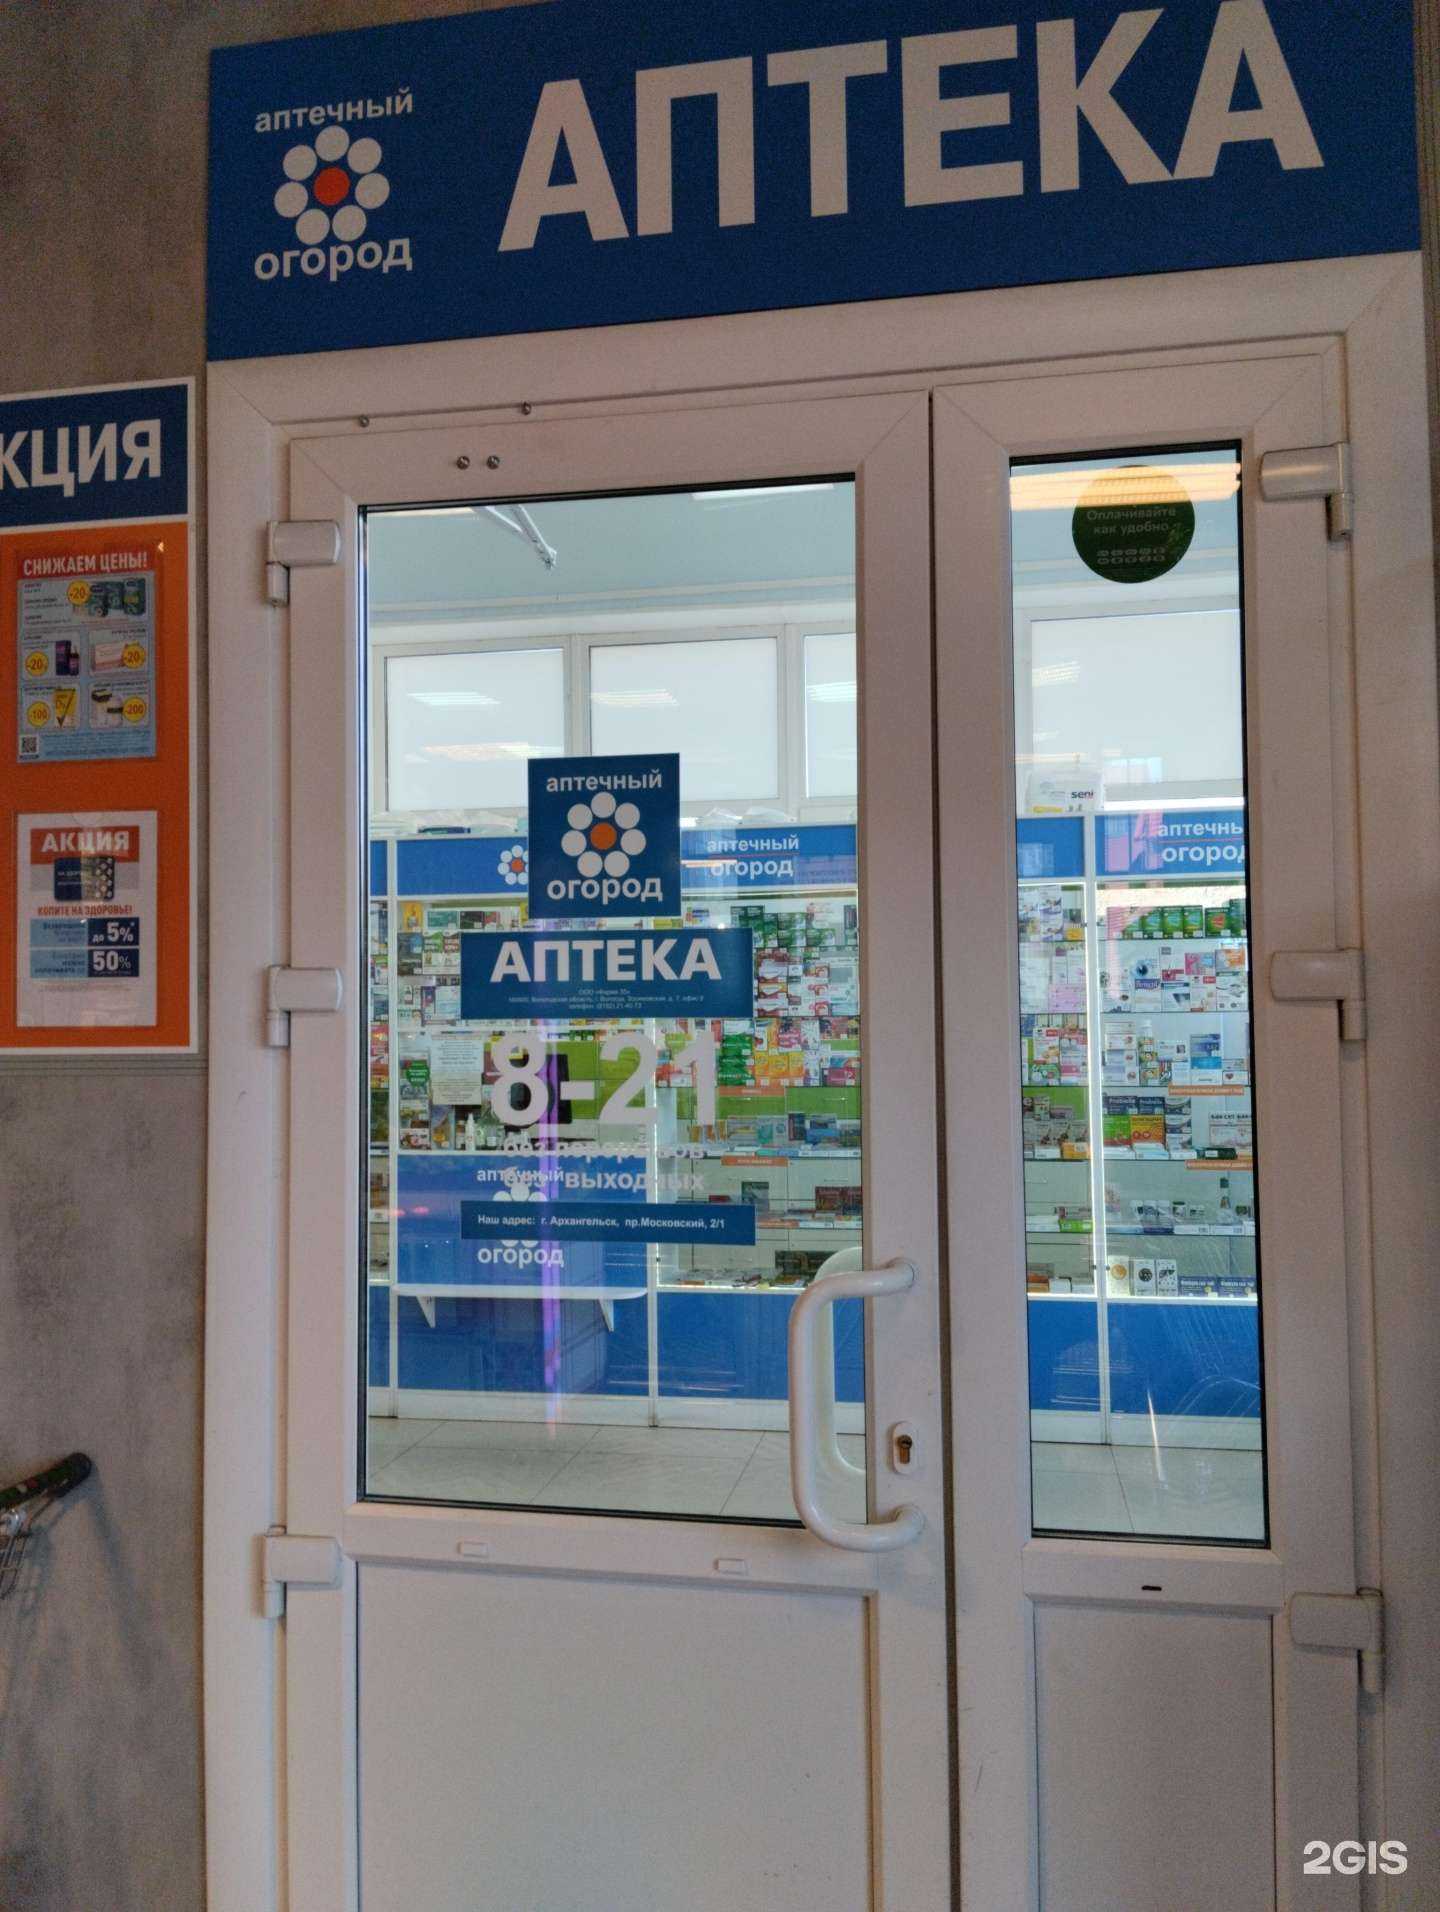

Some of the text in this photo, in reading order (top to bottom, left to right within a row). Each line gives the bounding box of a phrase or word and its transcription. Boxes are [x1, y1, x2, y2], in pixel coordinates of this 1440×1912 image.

[255, 86, 413, 133] аптечный
[497, 0, 1325, 253] АПТЕКА
[254, 237, 413, 282] огород
[1086, 506, 1177, 521] Оплачивайте
[1093, 521, 1169, 536] как удобно
[23, 551, 148, 577] СНИЖАЕМ ЦЕНЫ!
[545, 768, 663, 793] аптечный
[41, 830, 130, 854] АКЦИЯ
[706, 834, 800, 854] аптечный
[709, 858, 794, 879] огород
[546, 877, 663, 905] огород
[38, 903, 133, 917] КОПИТЕ НА ЗДОРОВЬЕ!
[490, 937, 722, 984] АПТЕКА
[491, 1030, 717, 1128] 8-21
[544, 1141, 706, 1164] перервов
[564, 1172, 705, 1193] выходных
[477, 1214, 726, 1231] Наш адрес: г. Архангельск, пр.Московский, 2/1
[476, 1246, 565, 1269] огород
